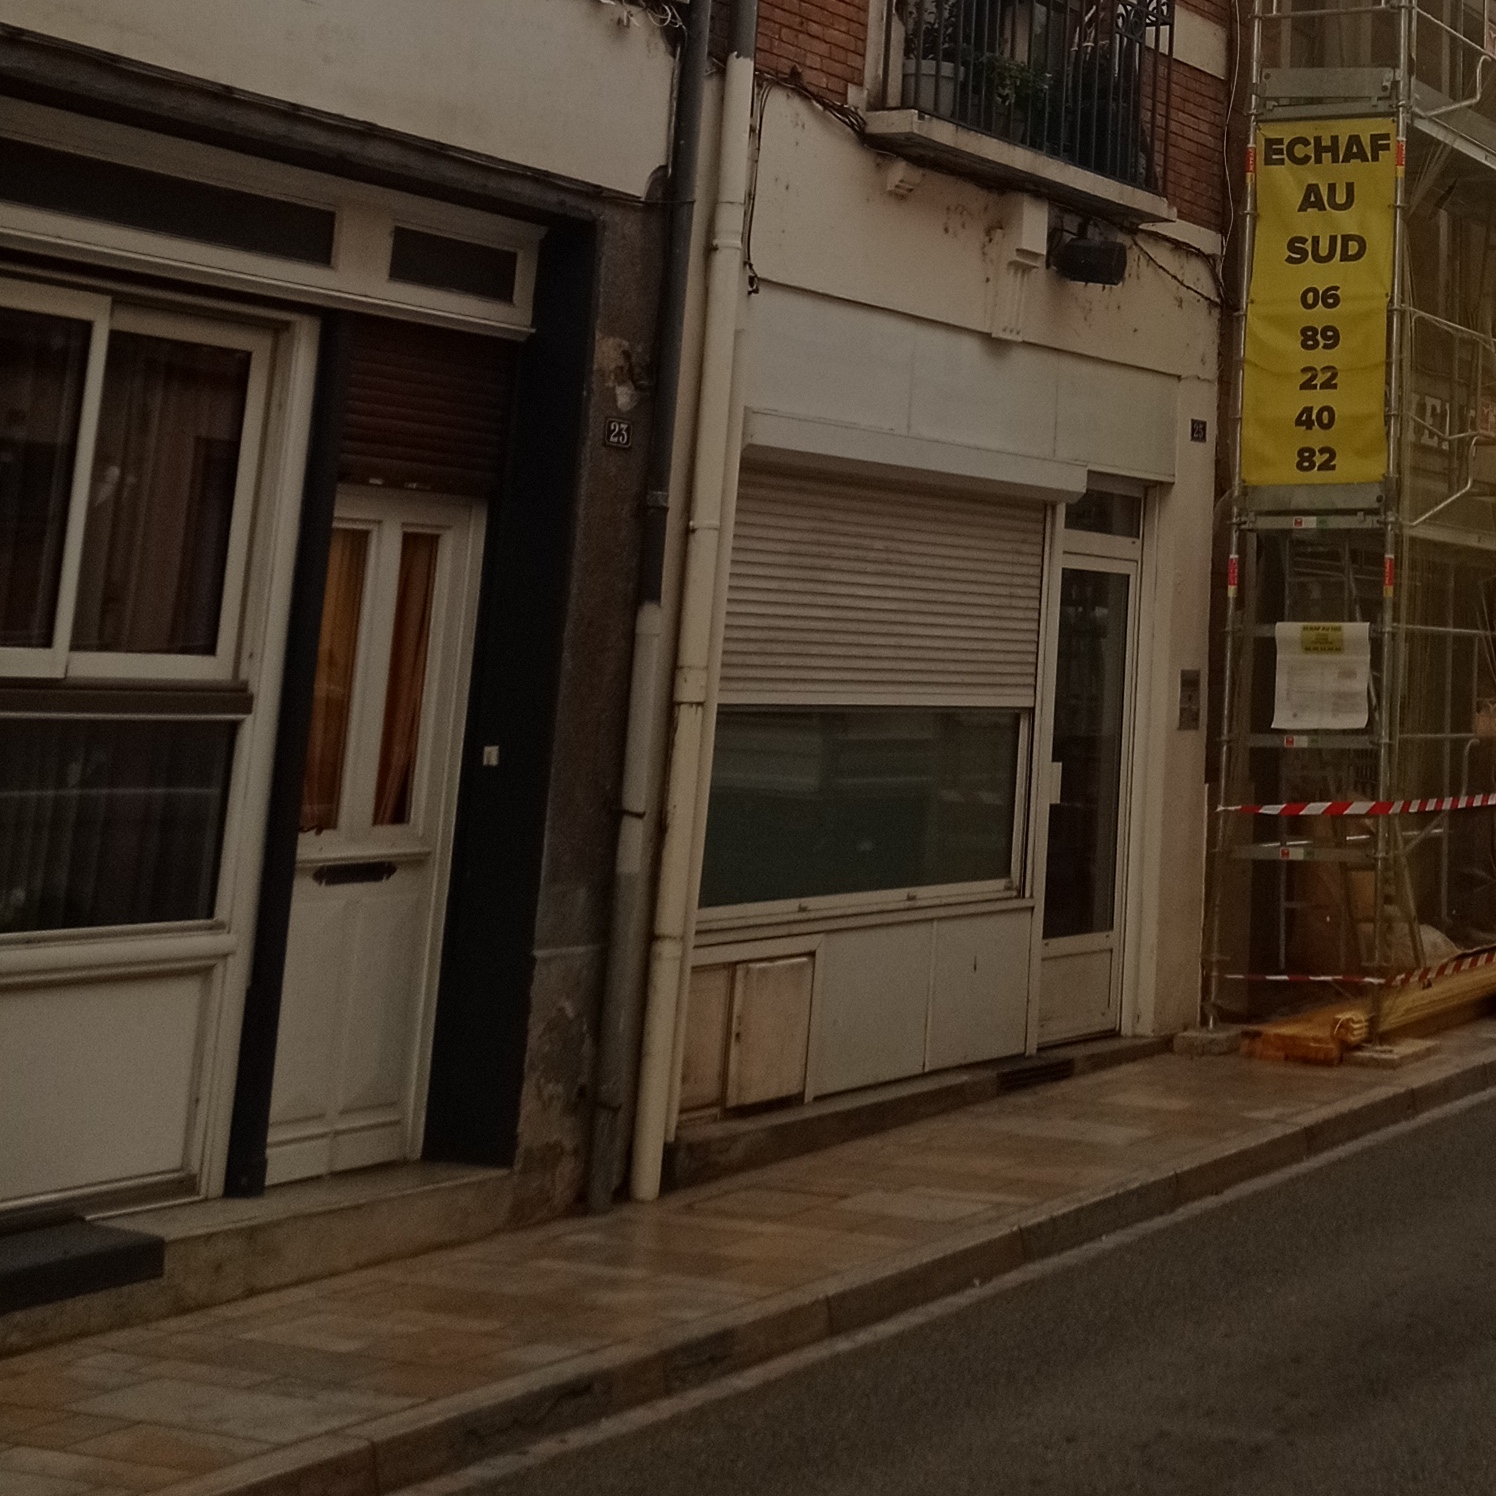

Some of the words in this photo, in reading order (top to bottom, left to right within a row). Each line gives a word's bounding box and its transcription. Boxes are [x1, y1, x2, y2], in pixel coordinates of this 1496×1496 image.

[1263, 133, 1391, 166] ECHAF
[1297, 181, 1356, 212] AU
[1284, 233, 1368, 265] SUD
[1300, 286, 1341, 310] 06
[1299, 325, 1341, 351] 89
[1298, 366, 1339, 392] 22
[1294, 405, 1336, 431] 40
[610, 421, 629, 444] 23
[1295, 446, 1337, 473] 82
